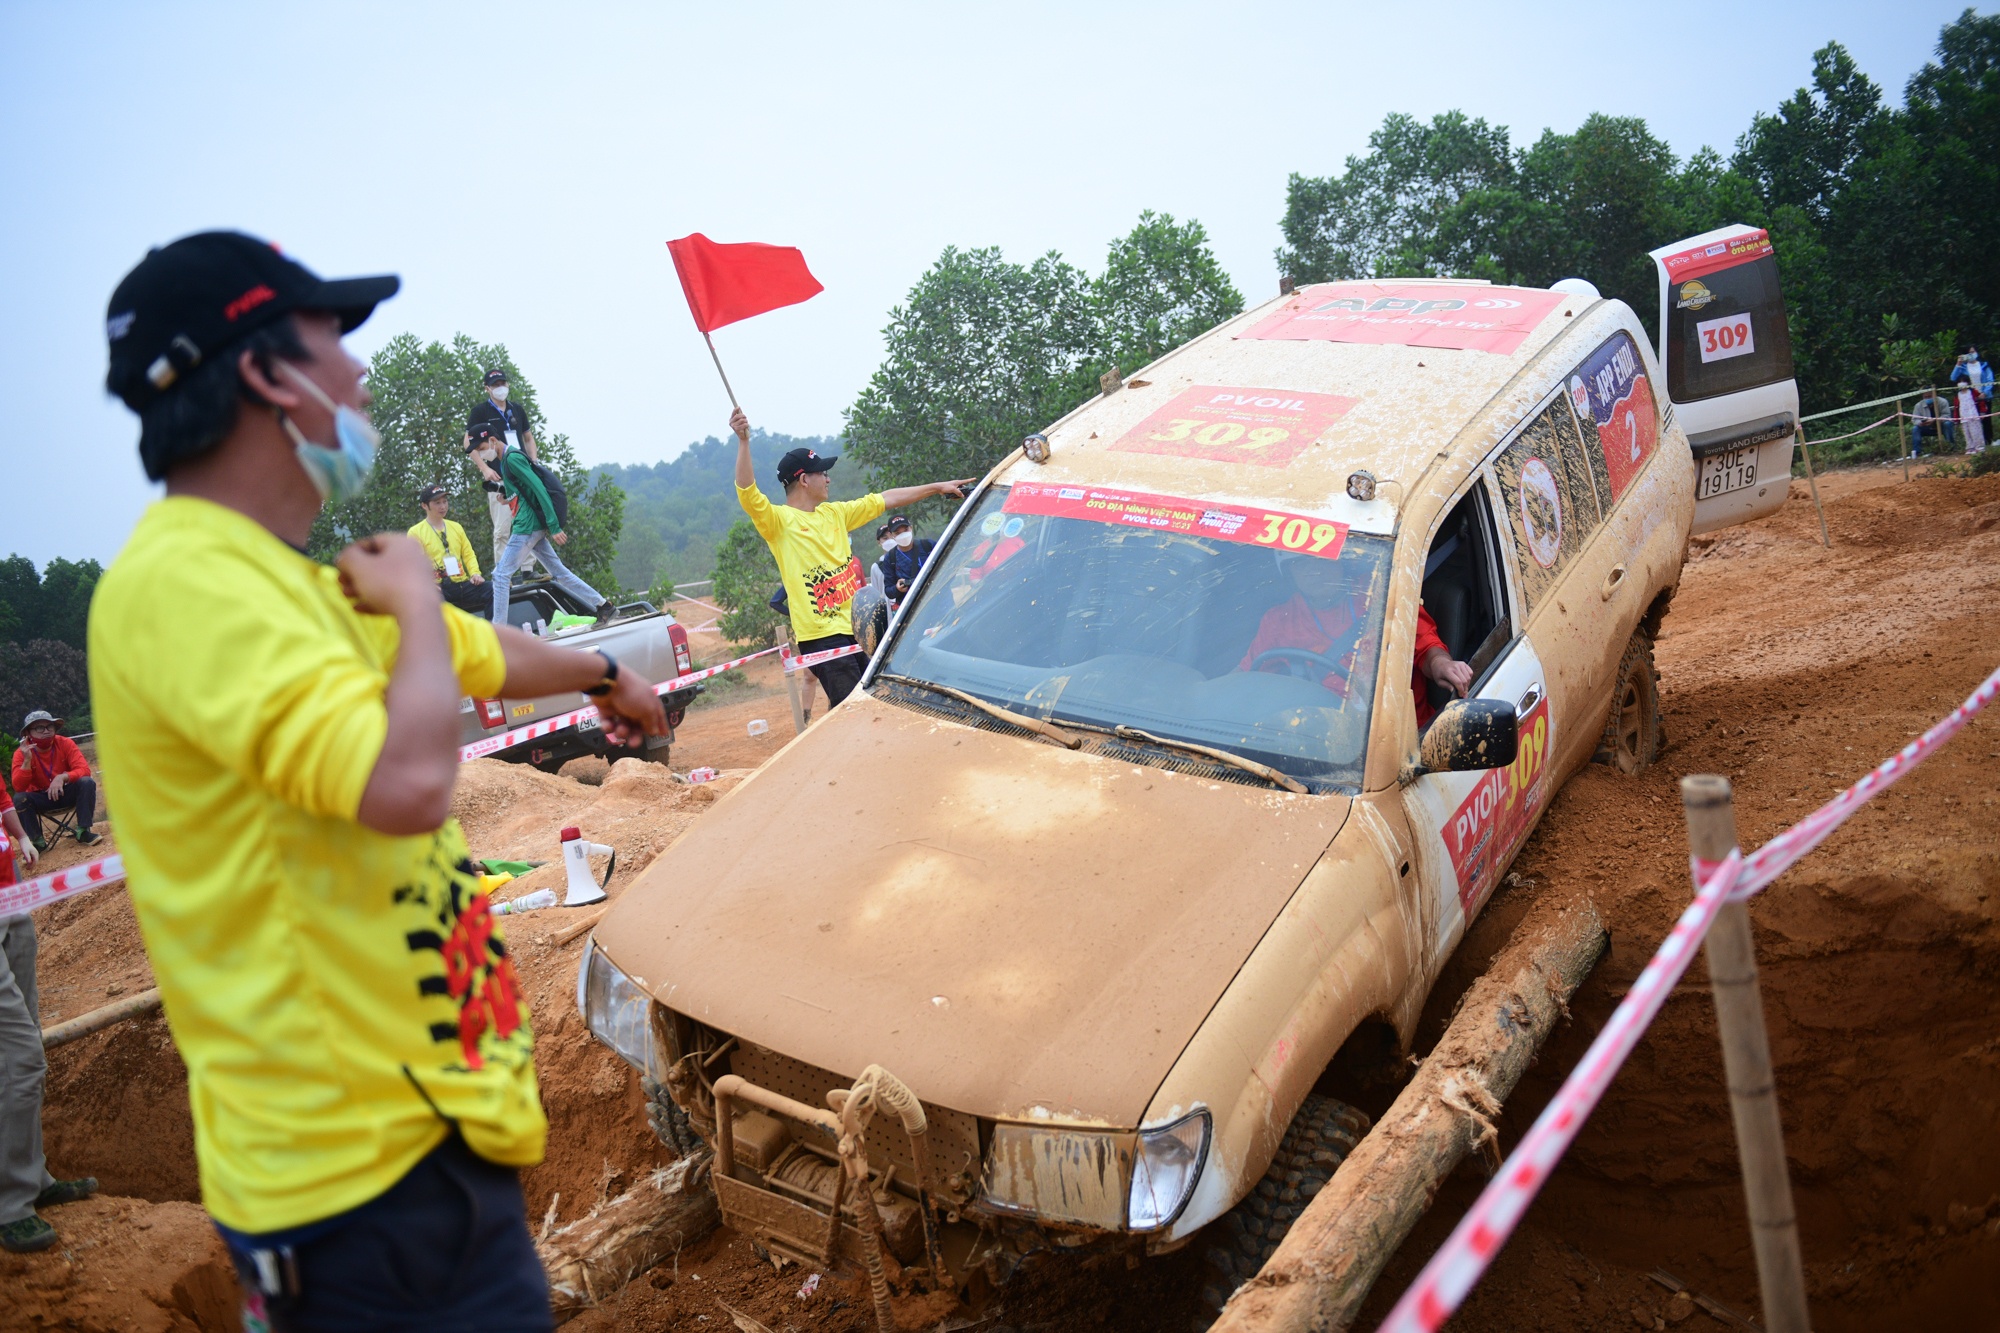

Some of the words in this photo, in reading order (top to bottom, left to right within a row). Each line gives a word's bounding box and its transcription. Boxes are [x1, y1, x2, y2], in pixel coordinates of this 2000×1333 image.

[1310, 297, 1467, 315] APP
[1702, 323, 1748, 353] 309
[1572, 385, 1586, 406] 309
[1596, 363, 1616, 407] APP
[1209, 393, 1306, 411] PVOIL
[1148, 419, 1291, 450] 309
[1625, 410, 1641, 464] 2
[1704, 447, 1725, 455] TOYOTA
[1727, 438, 1750, 450] LAND
[1751, 428, 1787, 444] CRUISER
[1715, 451, 1744, 473] 30E
[1704, 465, 1755, 496] 191.19
[1086, 499, 1106, 509] ÔTÔ
[1106, 502, 1124, 513] ĐỊA
[1125, 504, 1150, 516] HÌNH
[1172, 511, 1196, 522] NAM
[1122, 514, 1149, 525] PVOIL
[1149, 517, 1169, 527] CUP
[1203, 510, 1247, 523] OFFROAD
[1199, 517, 1224, 528] PVOIL
[1222, 521, 1243, 531] CUP
[1255, 513, 1336, 553] 309
[517, 708, 530, 716] 173
[1456, 766, 1507, 853] PVOIL
[1505, 715, 1546, 811] 309
